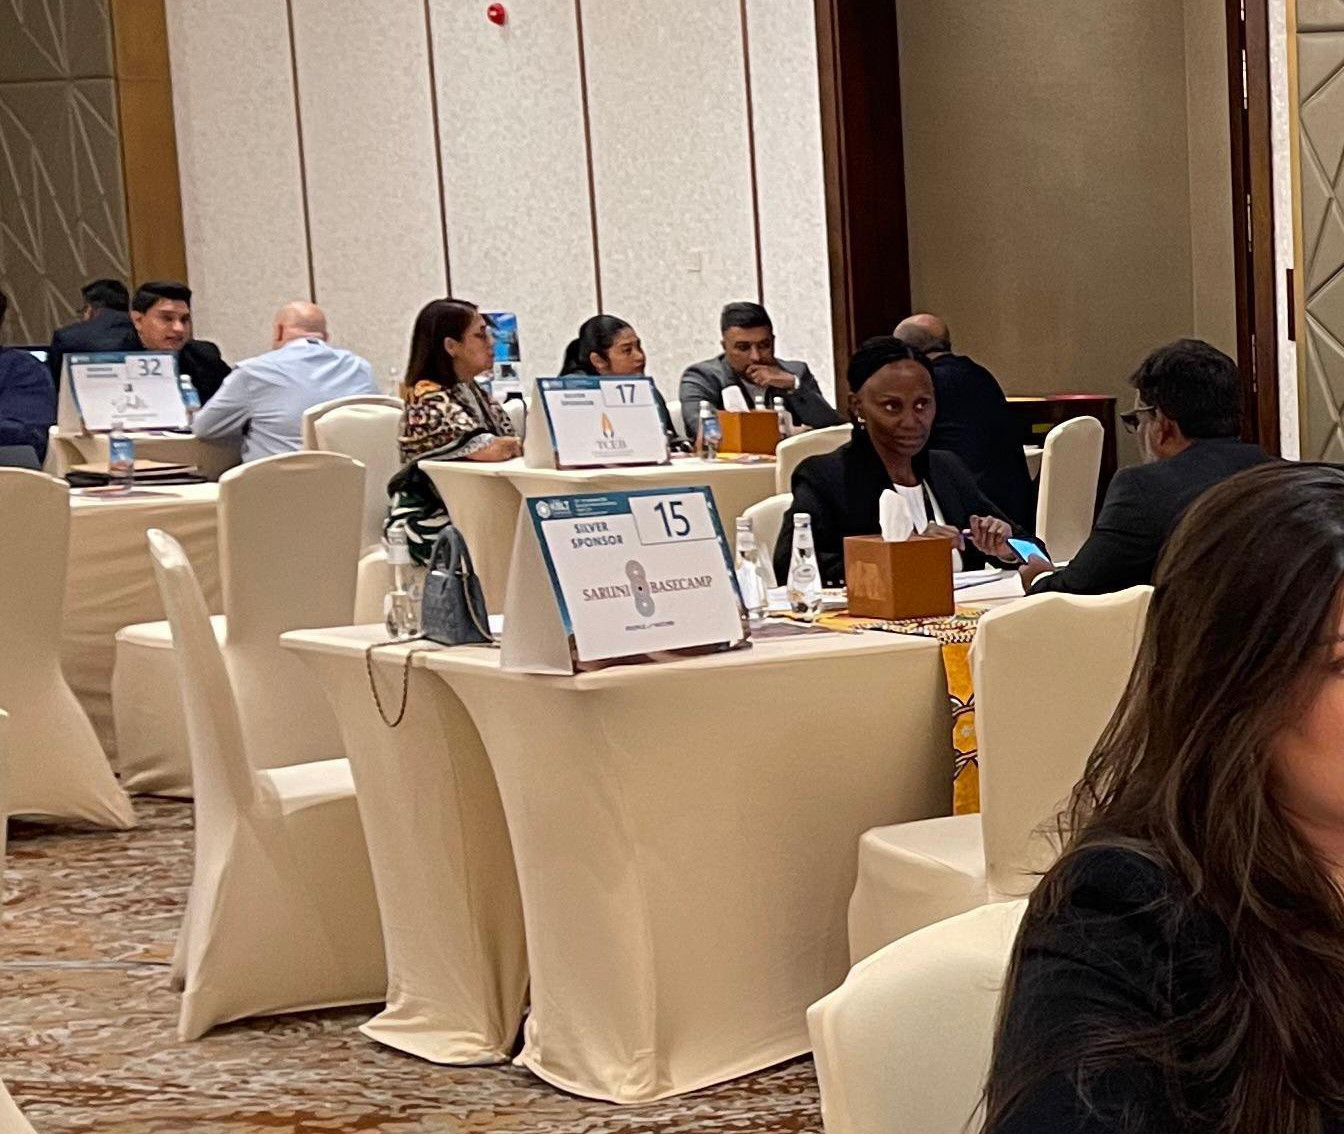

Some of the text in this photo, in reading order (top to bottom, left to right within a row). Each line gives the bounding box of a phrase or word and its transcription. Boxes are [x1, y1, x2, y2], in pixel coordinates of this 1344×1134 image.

[138, 358, 162, 376] 32
[616, 384, 635, 404] 17
[574, 522, 609, 534] SILVER
[653, 501, 691, 537] 15
[571, 535, 624, 549] SPONSOR
[583, 576, 713, 602] SARUNI BASECAMP
